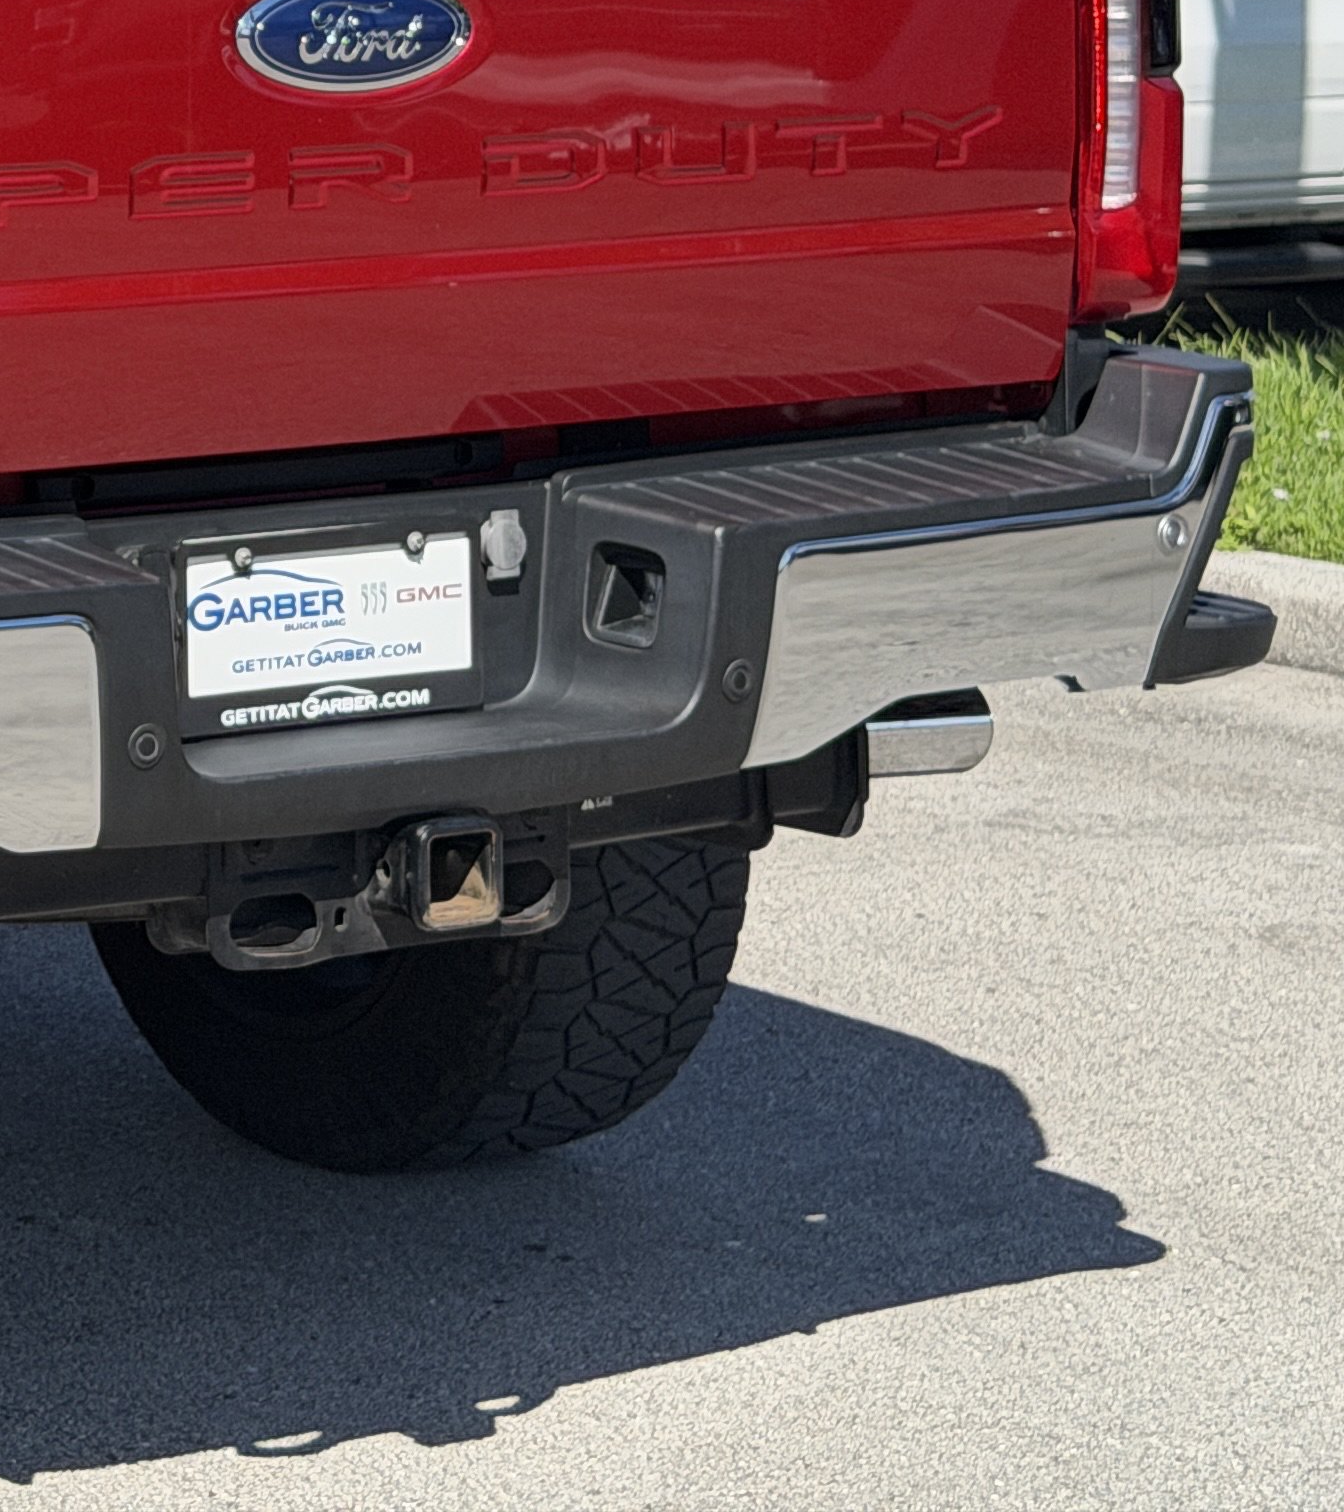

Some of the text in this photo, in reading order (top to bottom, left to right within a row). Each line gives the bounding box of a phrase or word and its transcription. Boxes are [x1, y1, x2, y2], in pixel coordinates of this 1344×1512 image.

[299, 1, 424, 65] Ford
[480, 105, 1004, 196] DUTY
[189, 588, 345, 631] GARBER
[395, 584, 463, 604] GMC
[283, 620, 318, 633] BUICK
[231, 640, 423, 675] GETITATGARBER.COM
[219, 687, 431, 728] GETITATGARBER.COM
